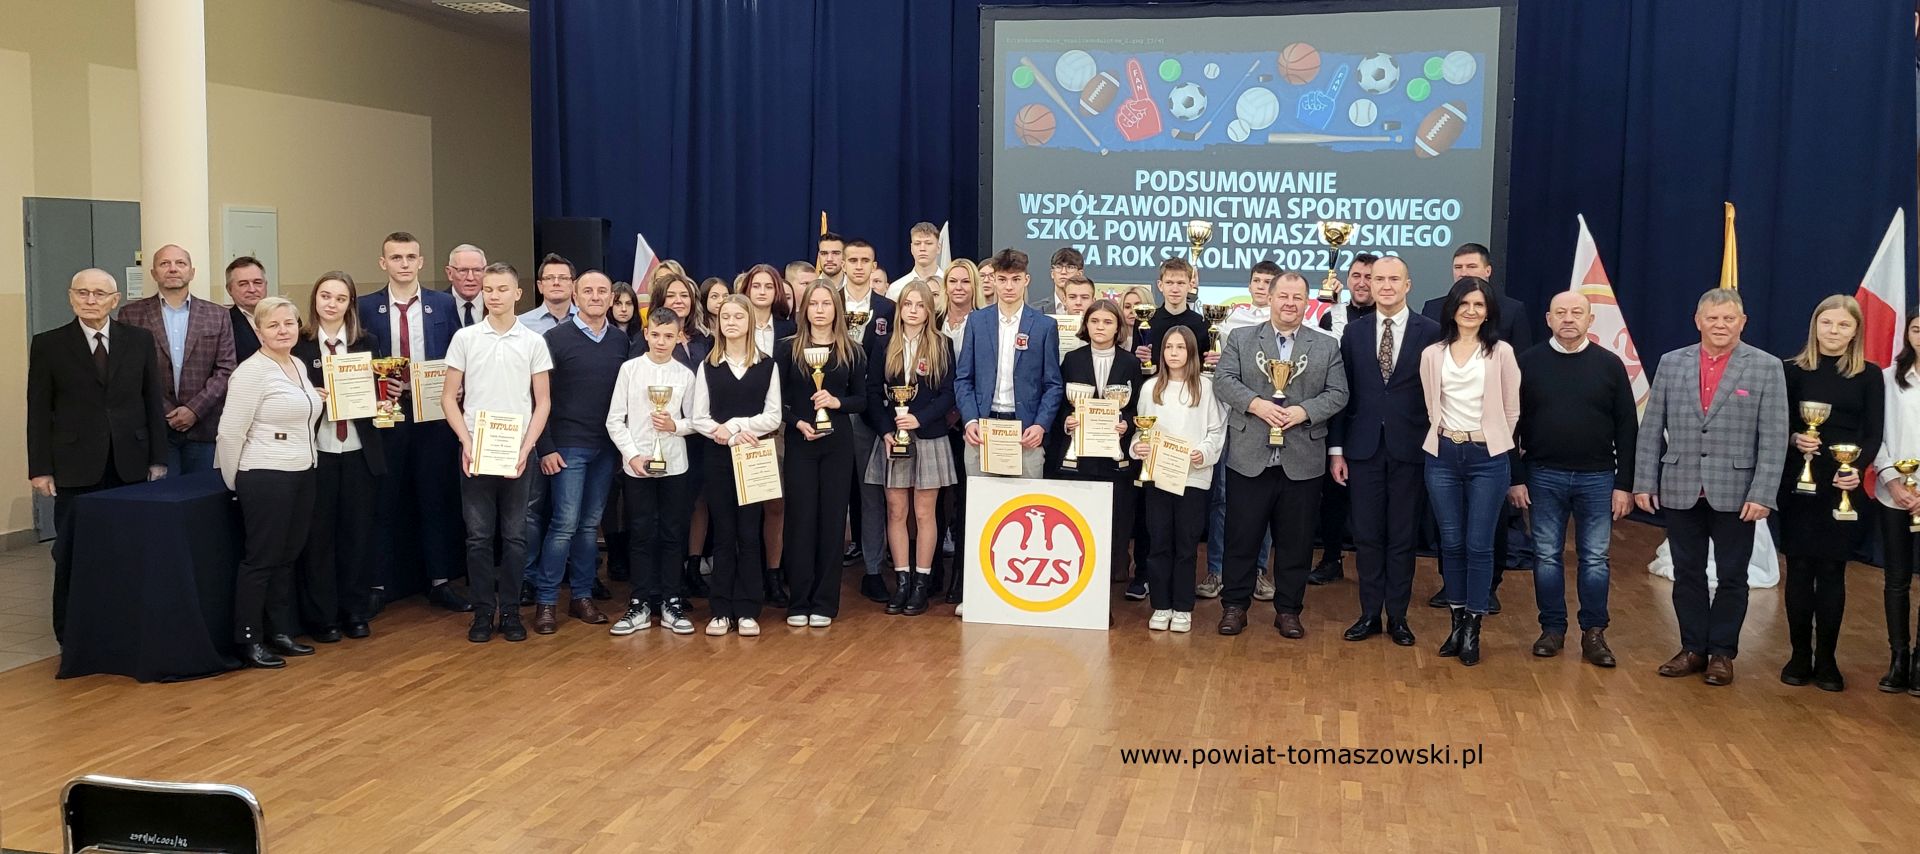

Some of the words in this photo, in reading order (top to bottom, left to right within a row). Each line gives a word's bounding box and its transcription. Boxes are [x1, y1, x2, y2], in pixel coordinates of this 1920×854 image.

[1133, 69, 1143, 92] FAN
[1135, 169, 1337, 194] PODSUMOWANIE
[1019, 189, 1282, 219] WSPÓŁZAWODNICTWA
[1286, 197, 1462, 221] SPORTOWEGO
[1026, 214, 1100, 241] SZKÓŁ
[1107, 244, 1156, 267] ROK
[1003, 556, 1072, 587] SZS
